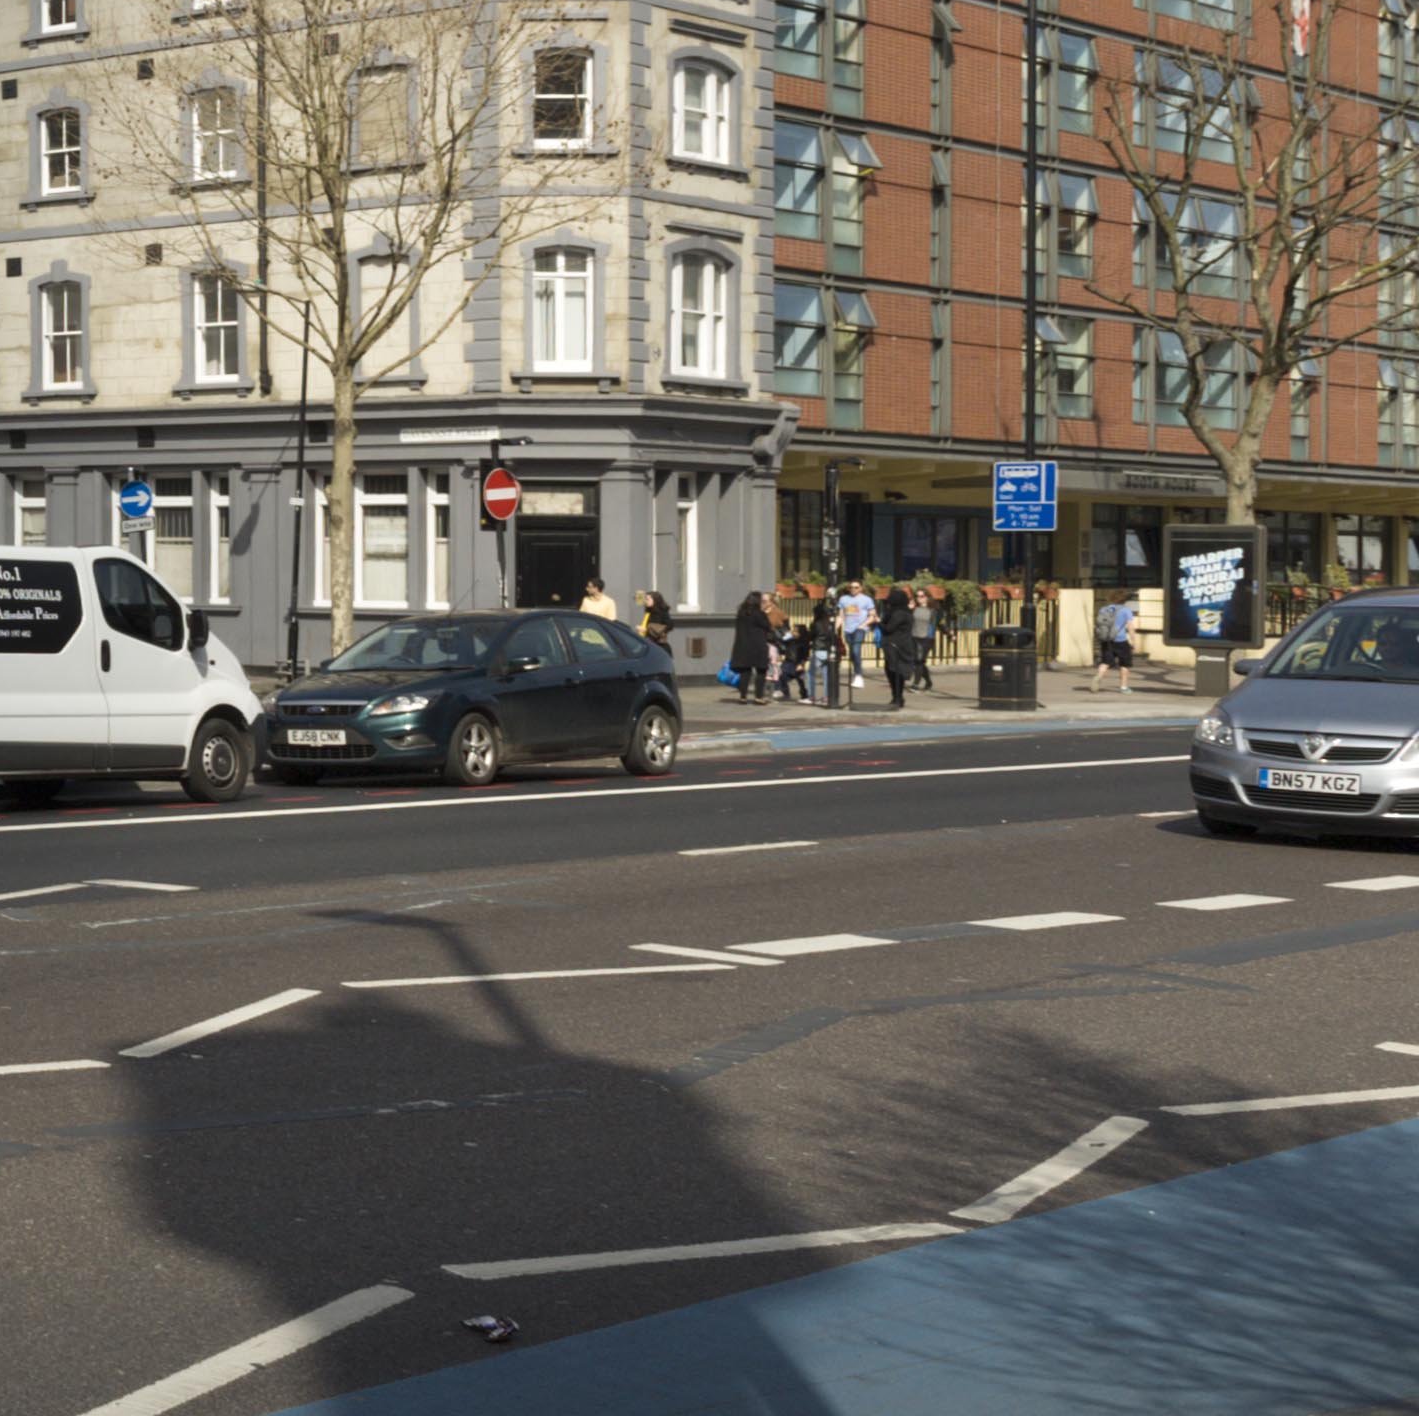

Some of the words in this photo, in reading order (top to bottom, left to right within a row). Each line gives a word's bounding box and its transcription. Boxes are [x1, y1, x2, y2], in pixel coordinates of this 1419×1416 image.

[1179, 547, 1244, 569] SHARPER
[12, 588, 63, 602] ORIGINALS
[1183, 581, 1236, 600] SWORD
[1271, 771, 1316, 790] BN57
[1322, 775, 1358, 792] KGZ
